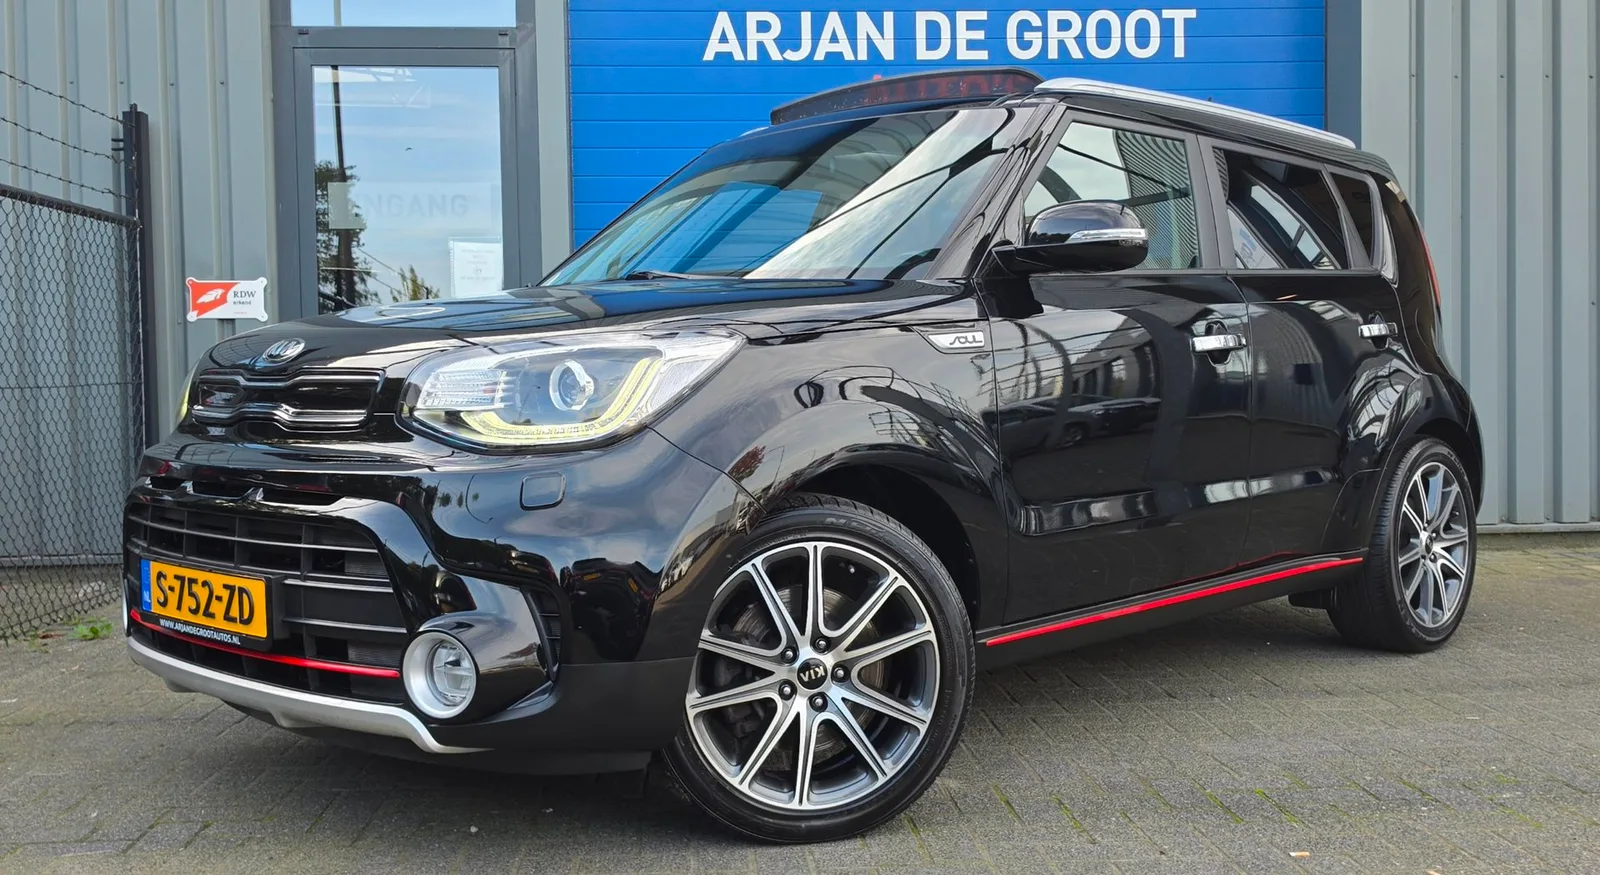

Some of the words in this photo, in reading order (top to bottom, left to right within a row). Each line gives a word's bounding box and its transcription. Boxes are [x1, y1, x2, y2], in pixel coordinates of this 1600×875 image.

[702, 11, 895, 61] ARJAN
[915, 11, 989, 60] DE
[1006, 9, 1197, 59] GROOT
[233, 290, 257, 298] RDW
[143, 590, 151, 603] NL
[155, 570, 255, 626] S-752-ZD
[800, 665, 825, 682] KIA
